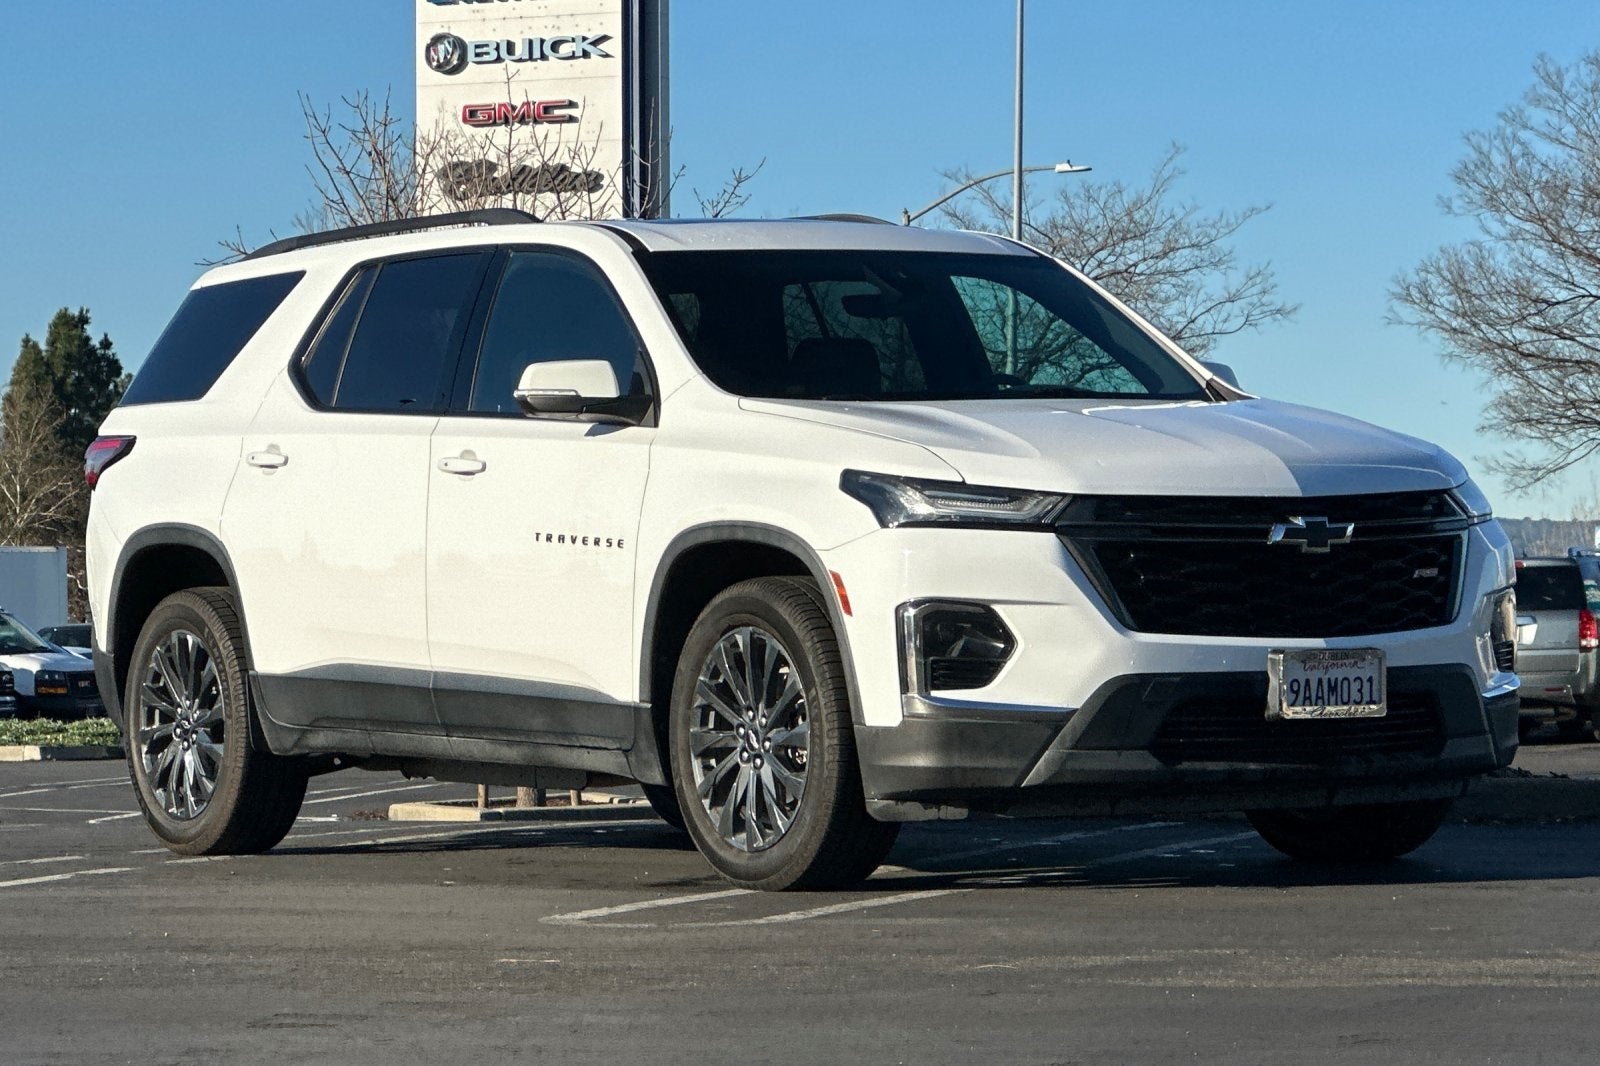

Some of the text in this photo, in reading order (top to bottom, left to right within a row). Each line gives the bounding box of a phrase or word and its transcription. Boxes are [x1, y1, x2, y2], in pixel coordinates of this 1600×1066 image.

[467, 34, 614, 63] BUICK
[462, 99, 576, 126] GMC
[535, 532, 625, 549] TRAVERSE
[1289, 676, 1377, 706] 9AAM031
